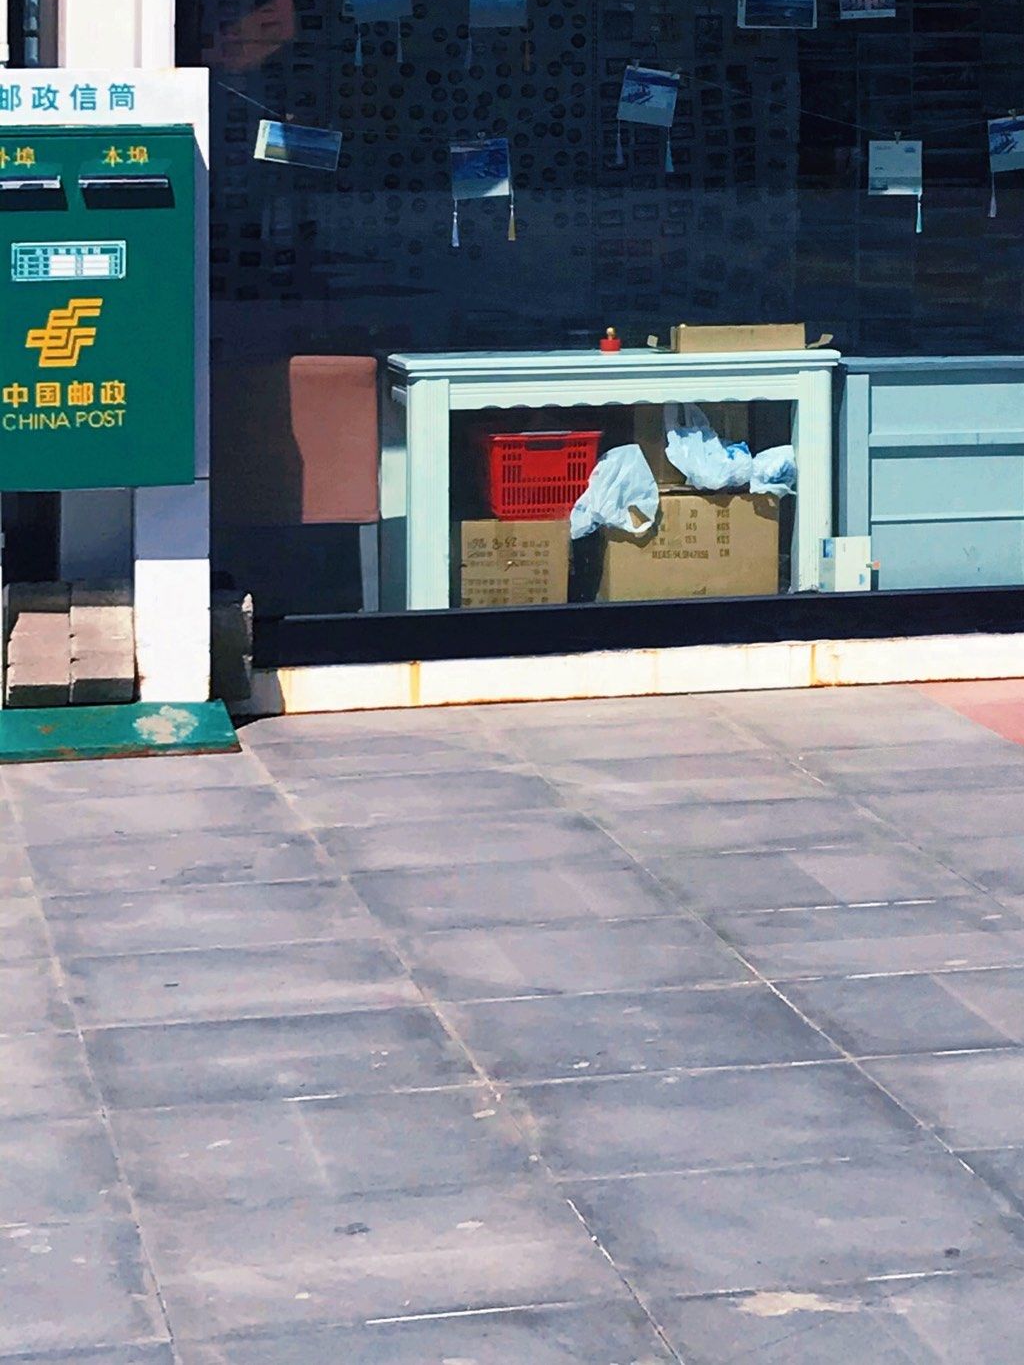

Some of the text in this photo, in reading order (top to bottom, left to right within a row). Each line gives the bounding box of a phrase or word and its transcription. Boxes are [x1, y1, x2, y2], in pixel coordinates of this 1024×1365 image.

[102, 146, 149, 168] 本埠
[2, 380, 127, 408] 中国邮政
[2, 410, 126, 431] CHINA POST
